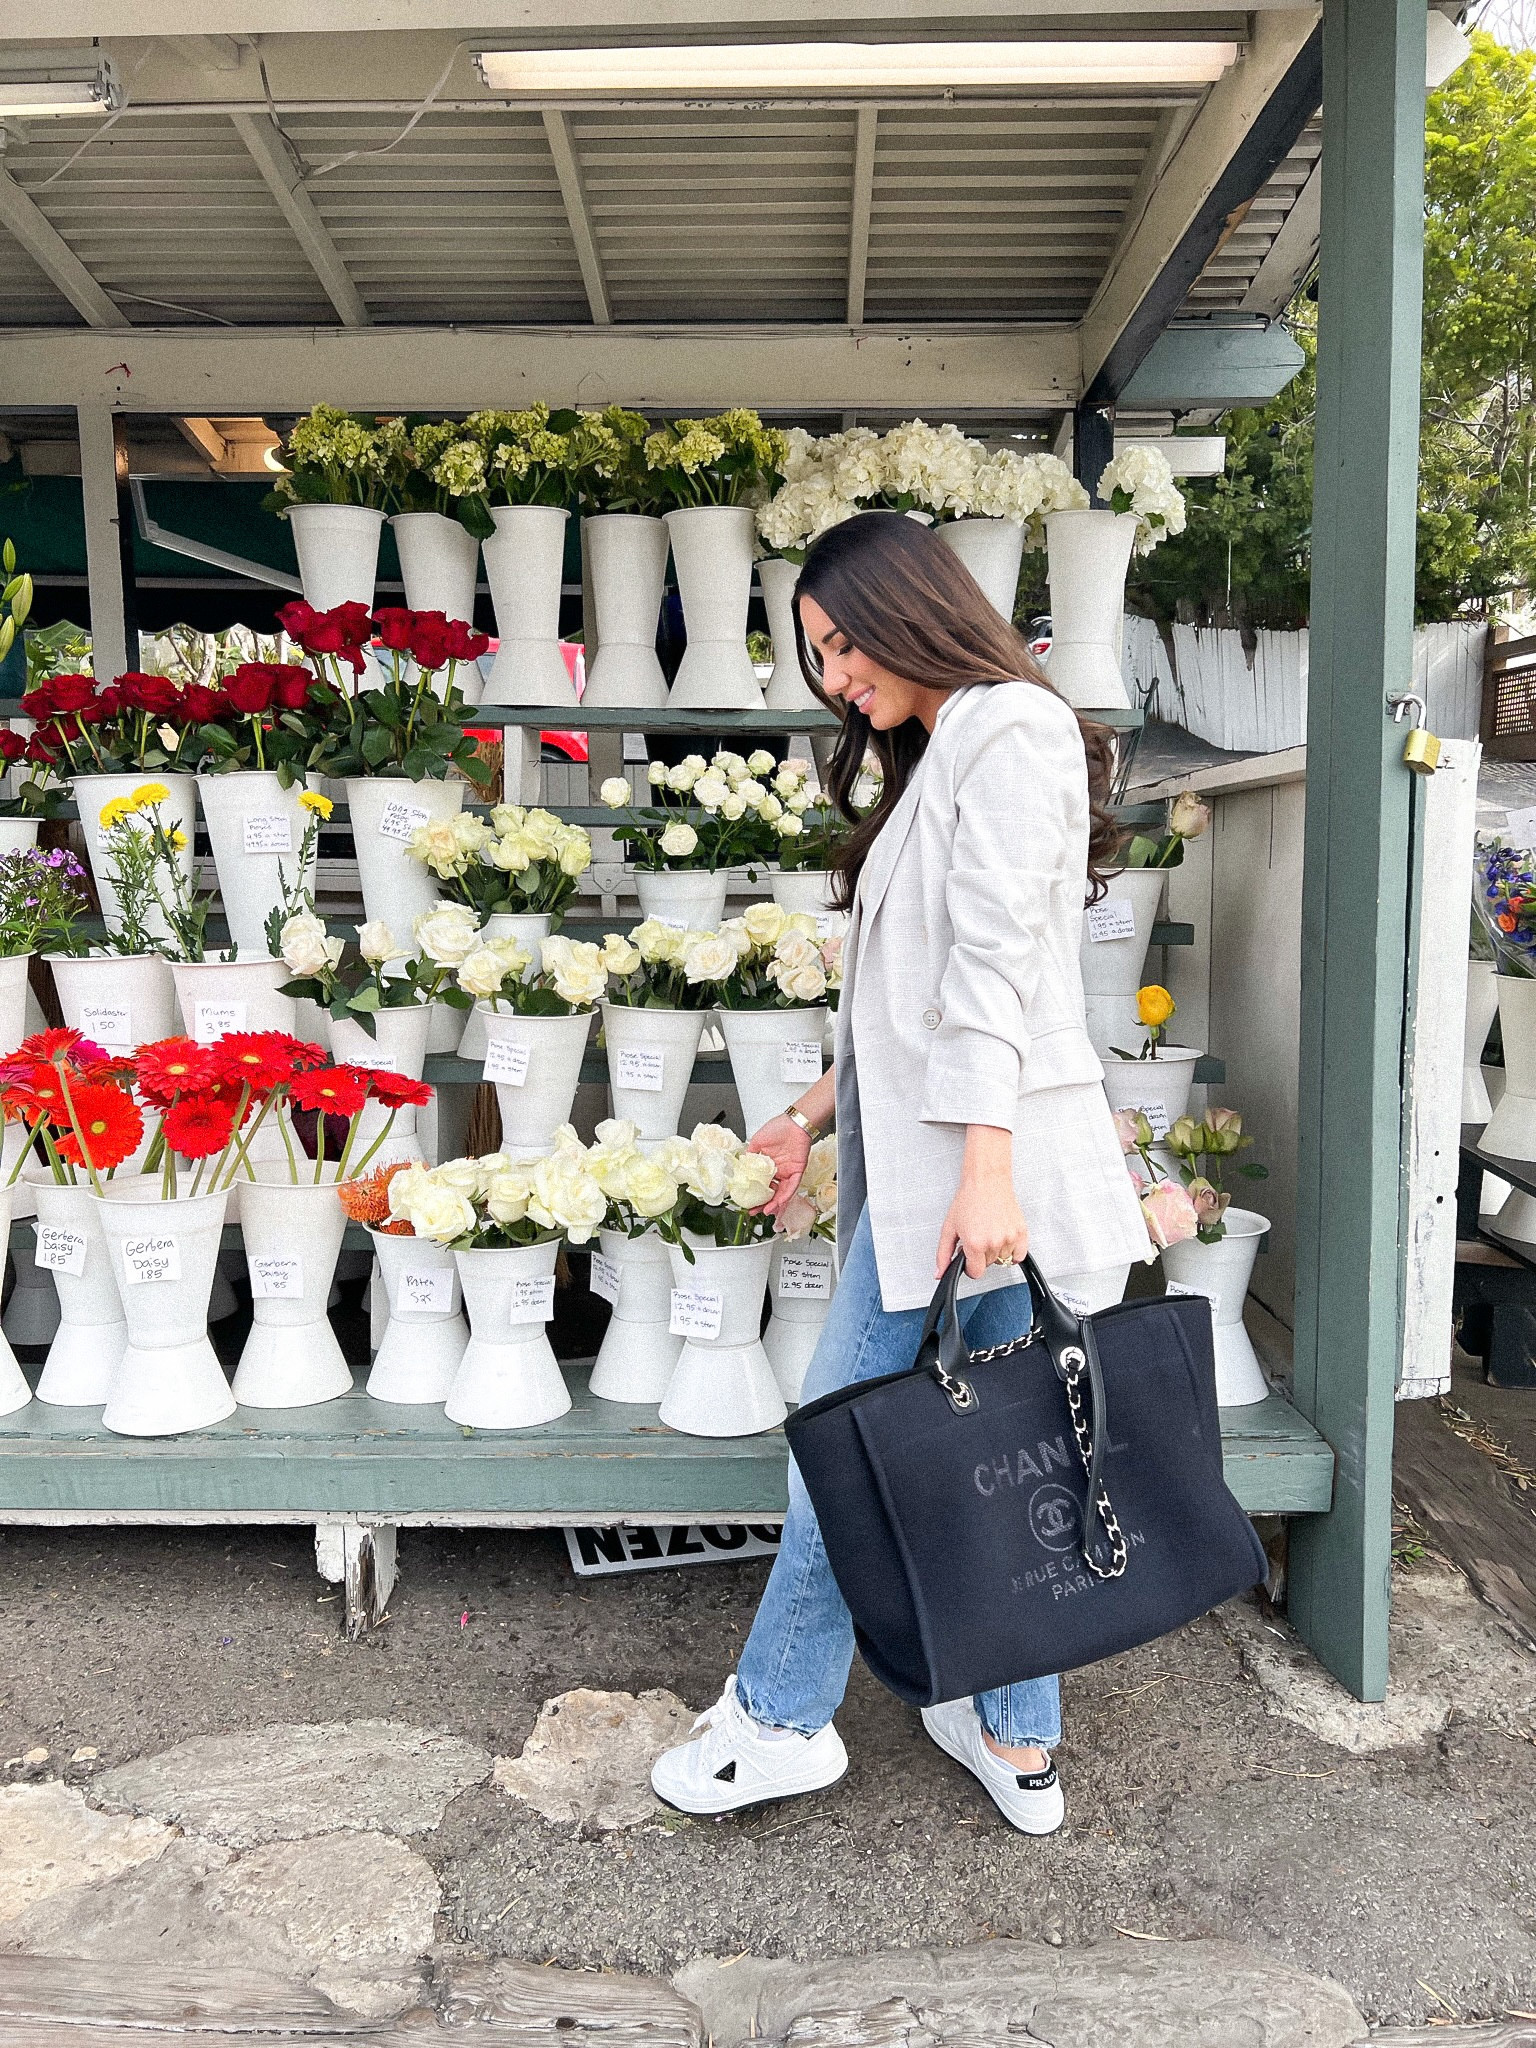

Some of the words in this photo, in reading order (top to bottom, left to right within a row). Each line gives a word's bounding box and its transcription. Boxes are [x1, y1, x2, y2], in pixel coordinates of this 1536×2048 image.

[84, 1007, 128, 1017] Solidaster
[43, 1239, 74, 1256] Daisy
[125, 1238, 175, 1257] Gerbera
[132, 1257, 170, 1270] Daisy
[254, 1258, 298, 1268] Gerbera
[783, 1256, 803, 1265] Rose
[805, 1259, 830, 1268] Special
[258, 1270, 289, 1281] Daisy
[801, 1271, 821, 1279] stem
[974, 1431, 1129, 1497] CHANL
